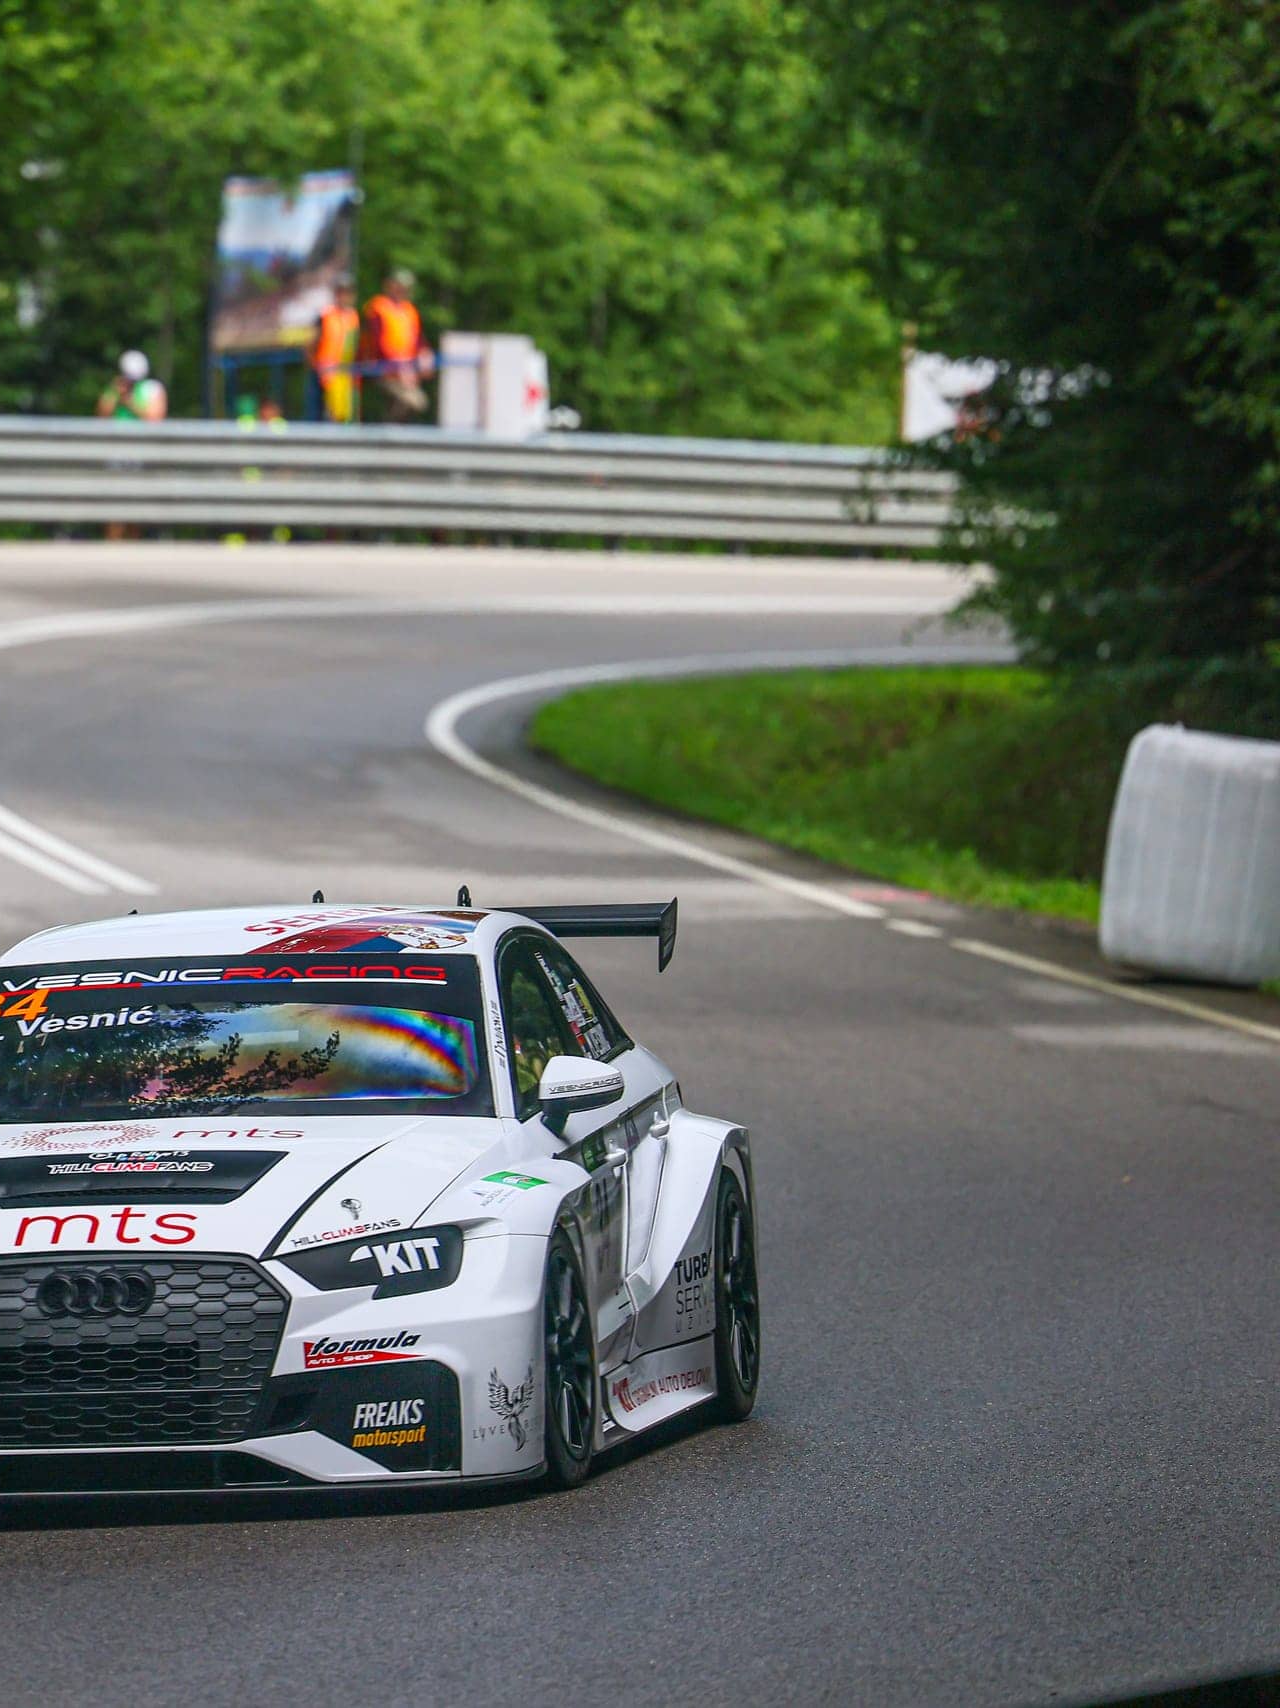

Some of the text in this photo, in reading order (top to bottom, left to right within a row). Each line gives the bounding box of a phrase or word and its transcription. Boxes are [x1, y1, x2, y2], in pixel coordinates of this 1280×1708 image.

[16, 1005, 155, 1037] Vesnić
[172, 1128, 305, 1139] mts
[14, 1206, 199, 1247] mts
[291, 1218, 402, 1248] HILLCLIMBFANS
[310, 1330, 422, 1355] formula
[353, 1398, 426, 1430] FREAKS
[352, 1425, 427, 1448] motorsport
